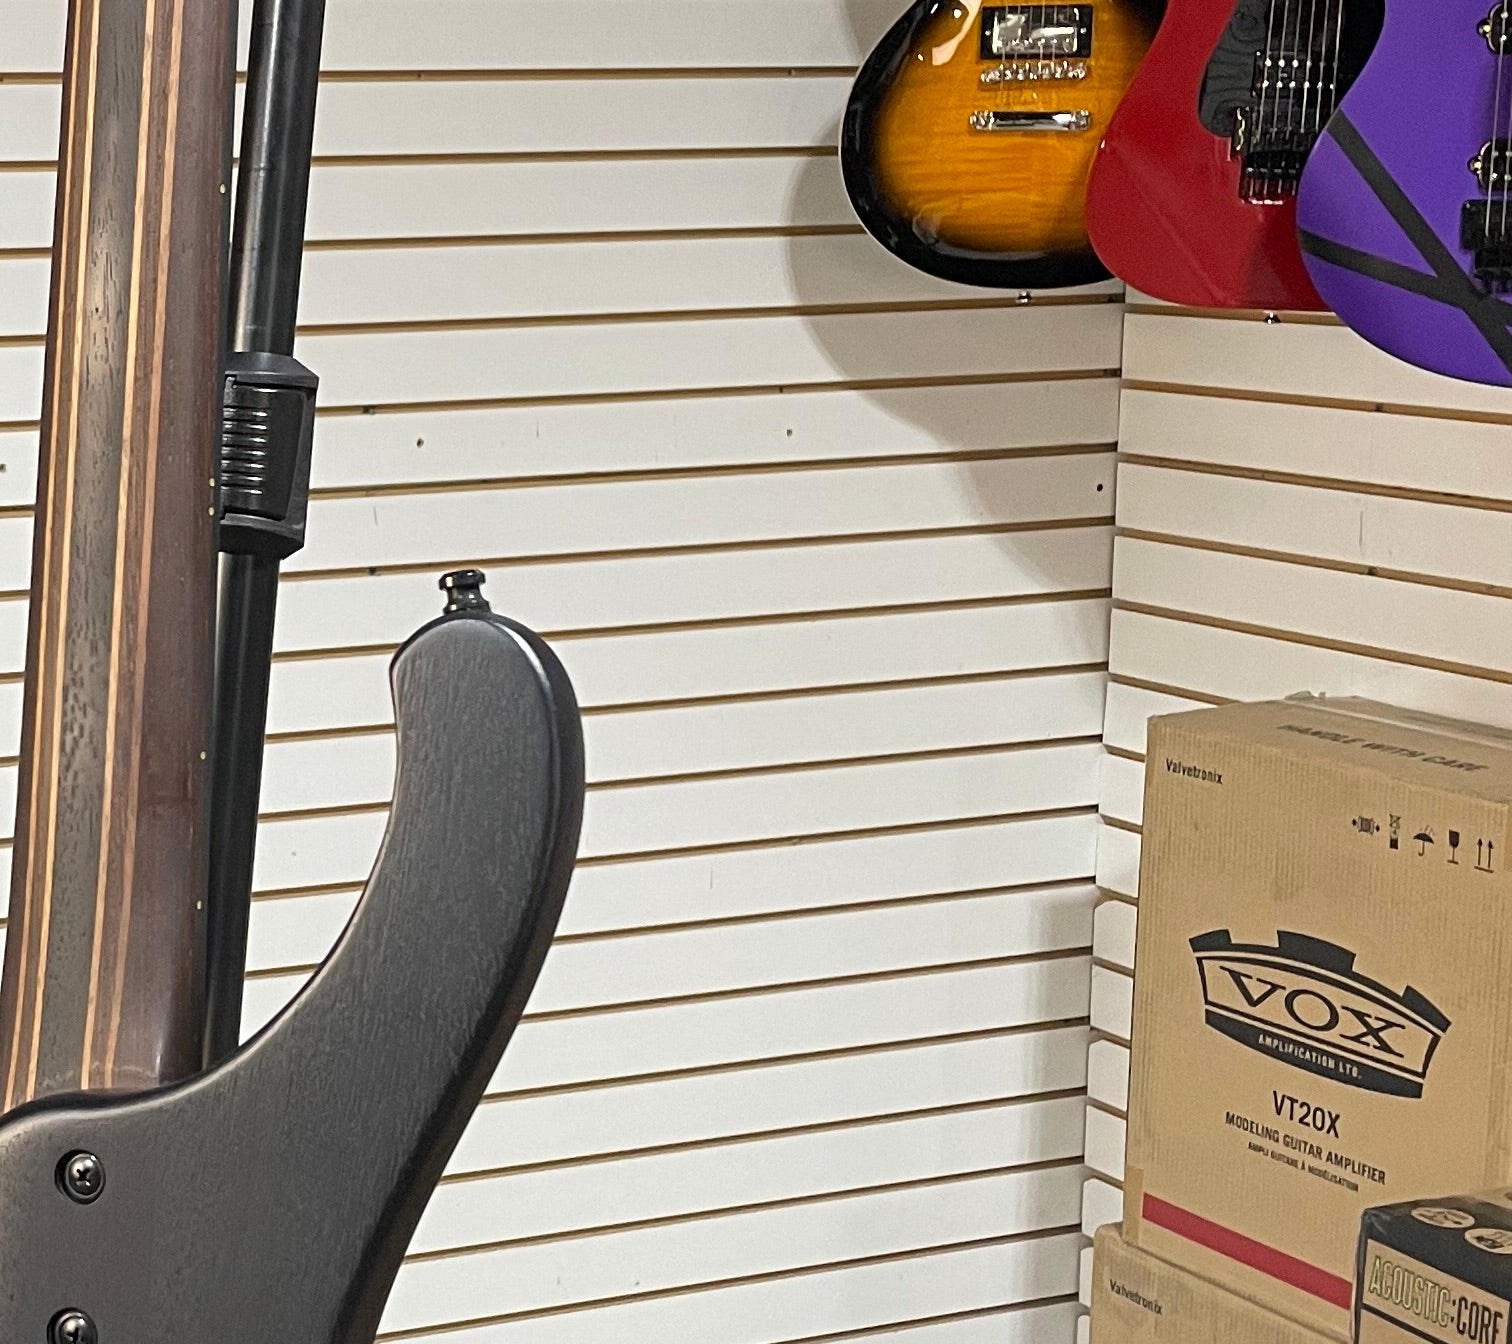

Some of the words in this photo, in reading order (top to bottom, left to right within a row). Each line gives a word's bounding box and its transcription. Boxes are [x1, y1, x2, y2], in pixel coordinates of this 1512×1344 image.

[1165, 757, 1224, 785] Valvetronix
[1219, 965, 1407, 1059] VOX
[1258, 1033, 1335, 1070] AMPLIFICATION
[1272, 1089, 1341, 1139] VT20X
[1224, 1111, 1280, 1144] MODELING
[1282, 1133, 1323, 1160] GUITAR
[1325, 1150, 1386, 1186] AMPLIFIER
[1109, 1278, 1163, 1316] Valvetronix
